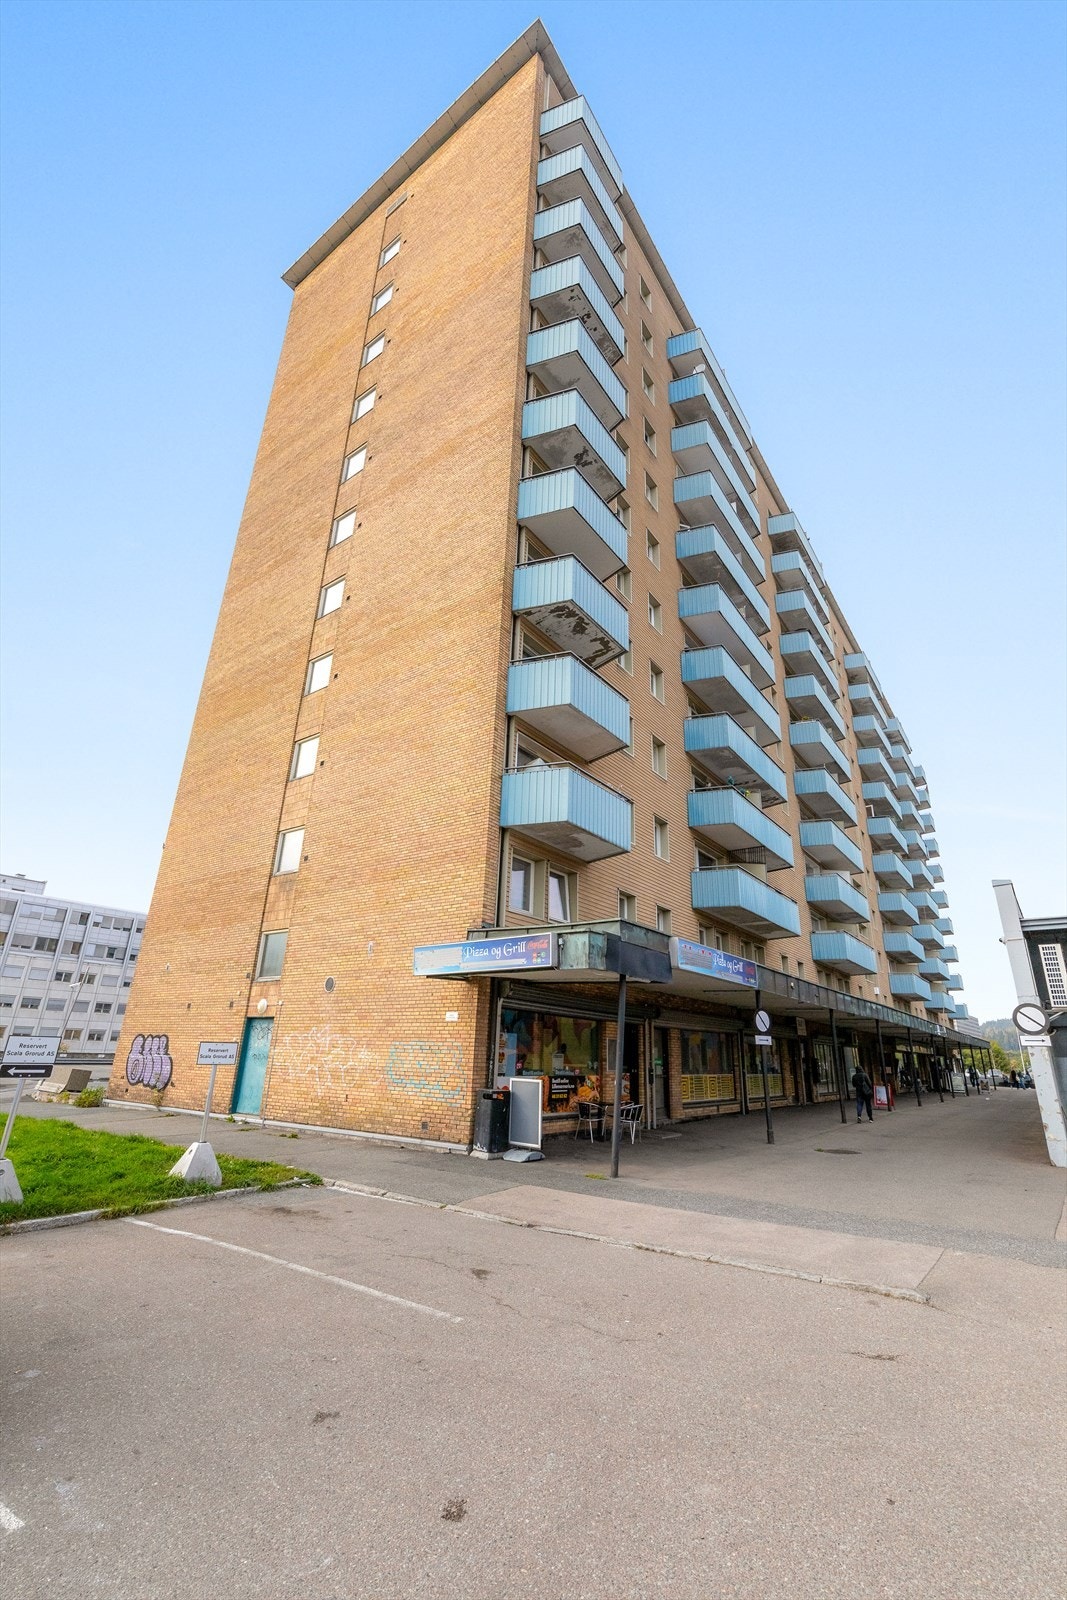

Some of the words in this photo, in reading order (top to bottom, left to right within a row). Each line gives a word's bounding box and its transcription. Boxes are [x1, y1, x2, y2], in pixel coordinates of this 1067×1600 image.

[463, 946, 489, 960] Pizza
[491, 947, 501, 959] og
[503, 941, 526, 957] Grill
